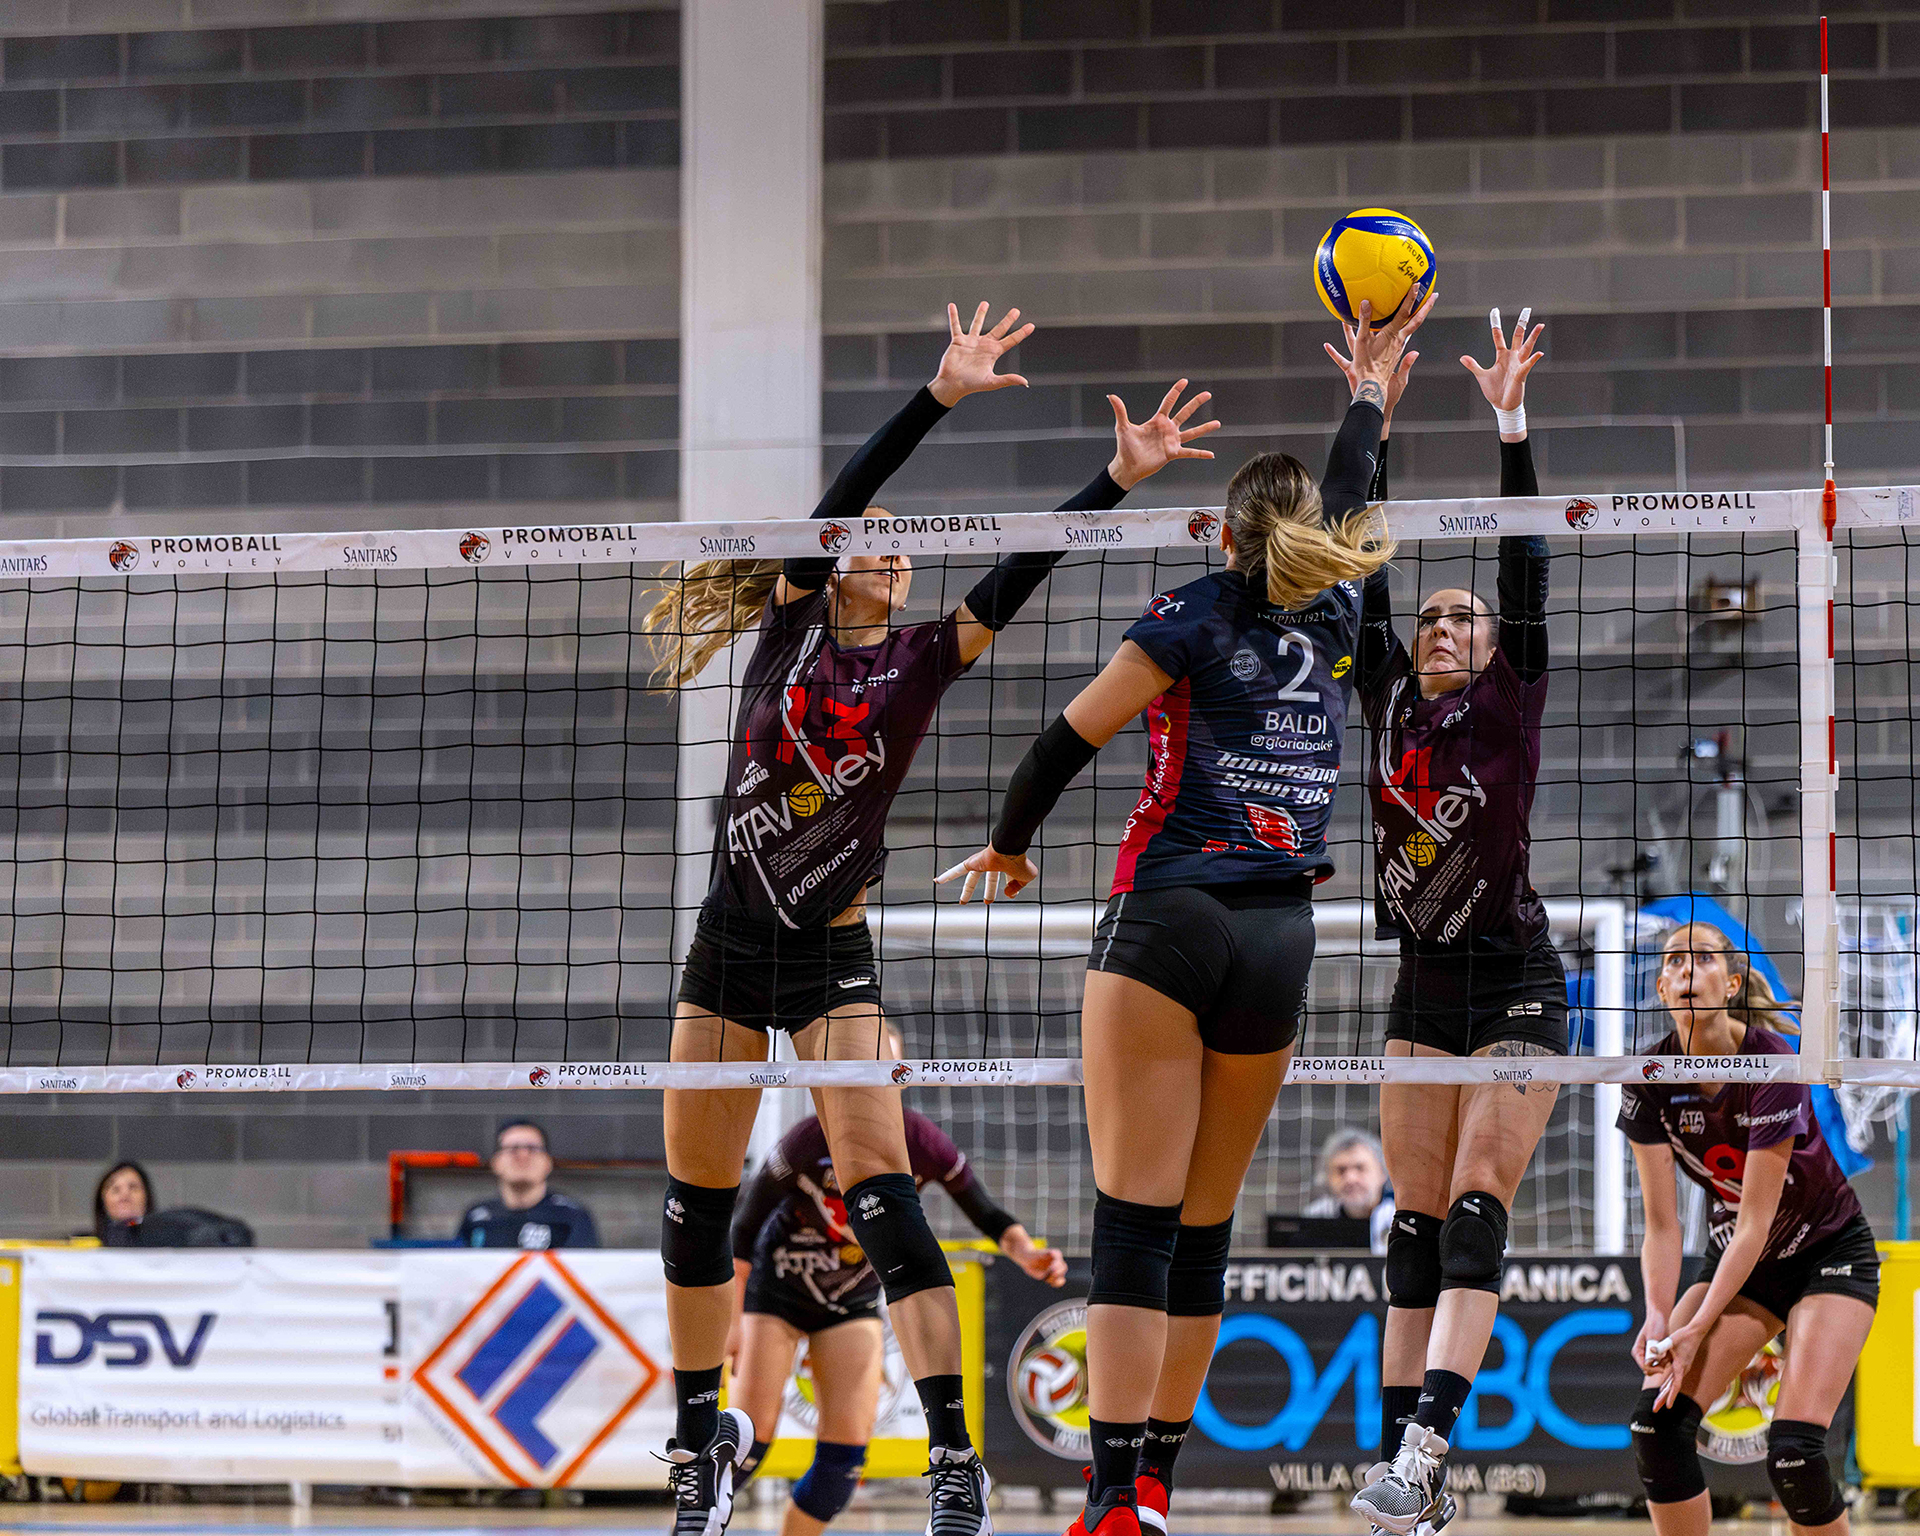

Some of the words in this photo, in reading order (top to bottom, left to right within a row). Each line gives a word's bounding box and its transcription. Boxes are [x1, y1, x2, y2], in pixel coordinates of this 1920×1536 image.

[1612, 493, 1756, 511] PROMOBALL
[864, 516, 1001, 535] PROMOBALL
[1439, 512, 1498, 532] SANITARS
[502, 525, 637, 544] PROMOBALL
[1065, 525, 1124, 544] SANITARS
[151, 536, 282, 554] PROMOBALL
[343, 545, 398, 563] SANITARS
[700, 535, 756, 554] SANITARS
[0, 555, 48, 573] ANITARS
[1277, 631, 1320, 703] 2
[1264, 711, 1328, 736] BALDI
[1381, 746, 1440, 820] 4
[786, 838, 860, 905] Walliance
[558, 1065, 648, 1076] PROMOBALL
[921, 1060, 1013, 1074] PROMOBALL
[1293, 1059, 1386, 1071] PROMOBALL
[1673, 1057, 1770, 1069] PROMOBALL
[205, 1067, 292, 1079] PROMOBALL
[1493, 1068, 1533, 1081] SANITARS
[1224, 1263, 1378, 1302] FFICINA
[35, 1312, 218, 1367] DSV
[31, 1406, 99, 1430] Global
[105, 1407, 200, 1438] Transport
[210, 1408, 247, 1430] and
[255, 1408, 346, 1437] Logistics
[1268, 1462, 1352, 1491] VILLA
